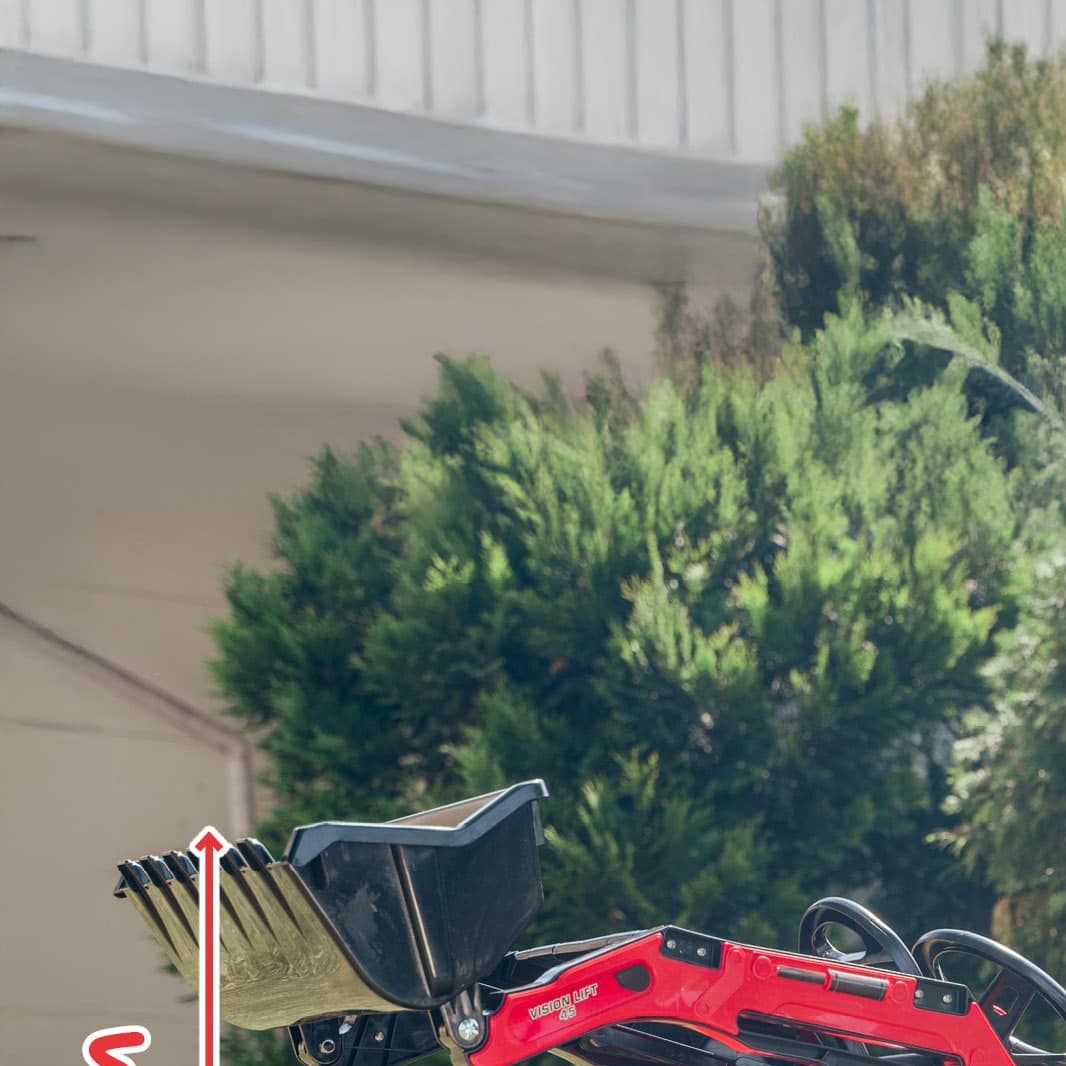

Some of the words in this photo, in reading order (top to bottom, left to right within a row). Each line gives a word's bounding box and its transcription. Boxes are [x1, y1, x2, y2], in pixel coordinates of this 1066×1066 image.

[528, 993, 571, 1020] VISION
[573, 982, 599, 1004] LIFT
[559, 1004, 577, 1021] 45
